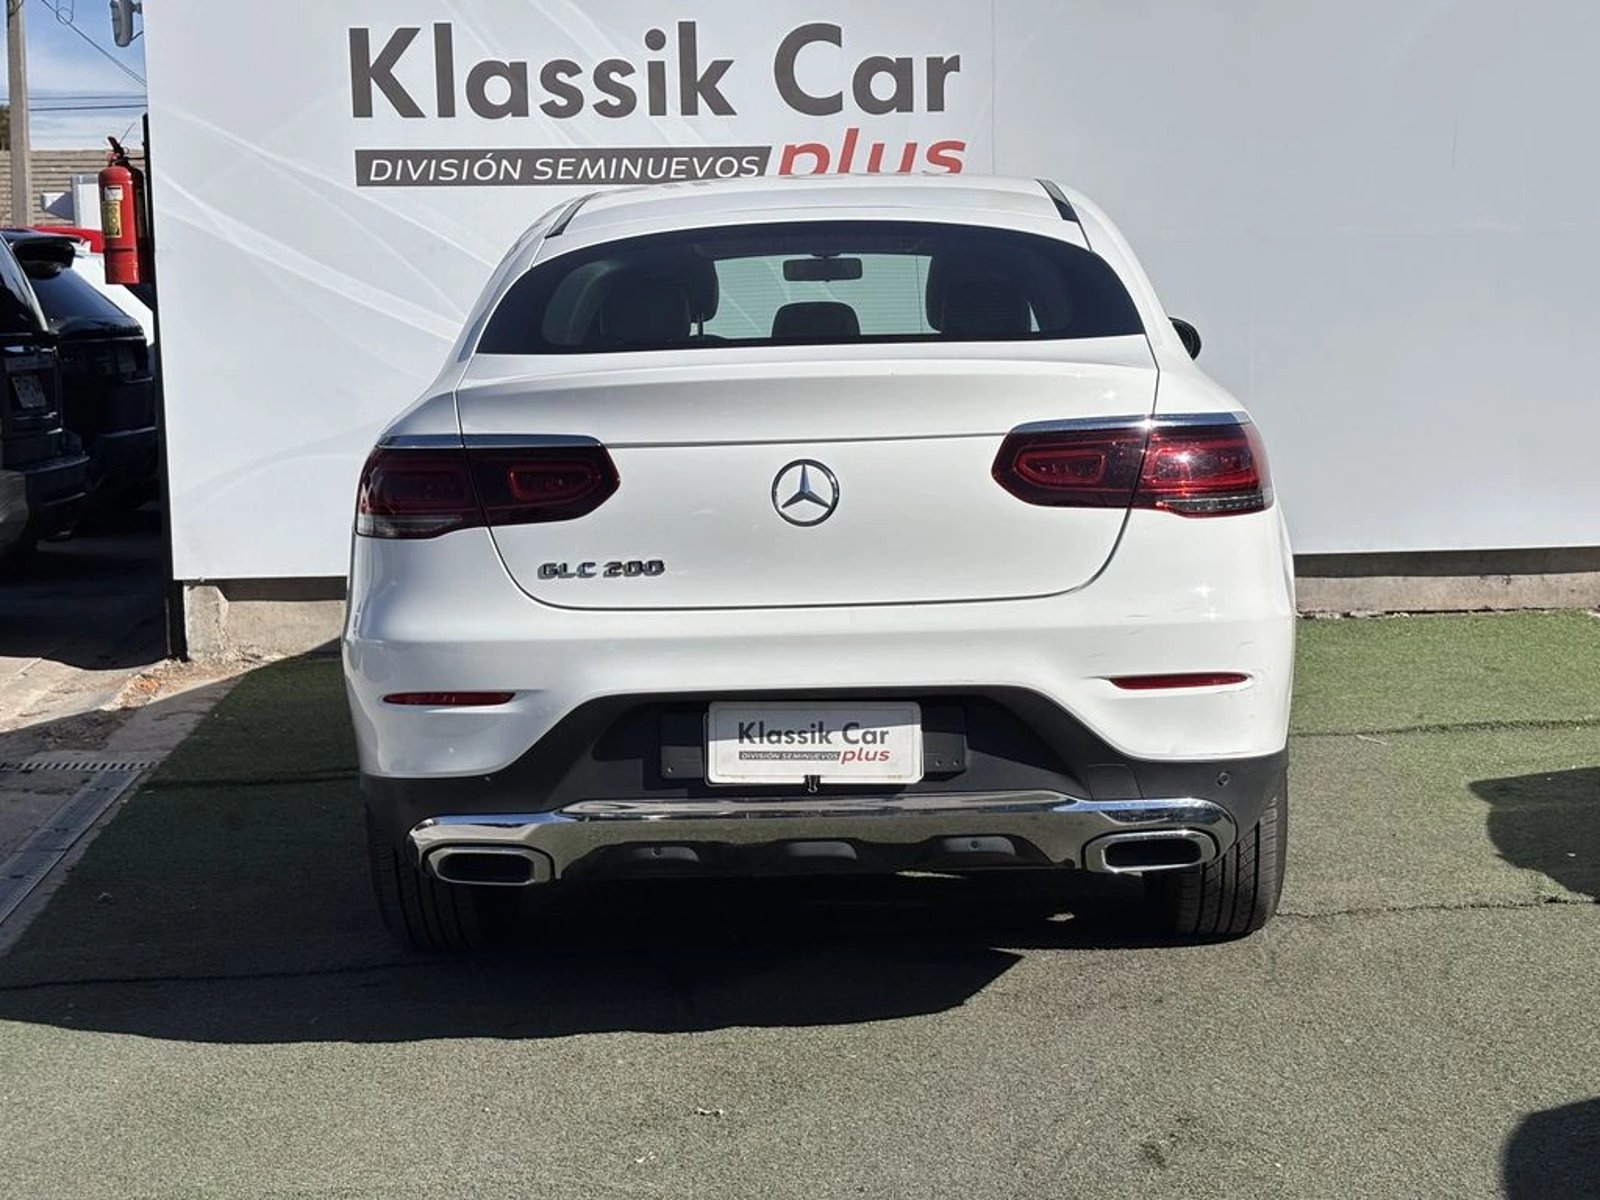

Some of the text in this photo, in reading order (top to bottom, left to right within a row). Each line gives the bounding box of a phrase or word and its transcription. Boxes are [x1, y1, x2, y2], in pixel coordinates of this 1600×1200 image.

[348, 21, 962, 118] Klassik Car
[778, 128, 966, 175] plus
[369, 153, 761, 183] DIVISIÓN SEMINUEVOS
[538, 560, 665, 579] GLC 200
[738, 721, 889, 744] Klassik Car
[782, 752, 838, 760] SEMINUEVOS
[840, 747, 890, 764] plus
